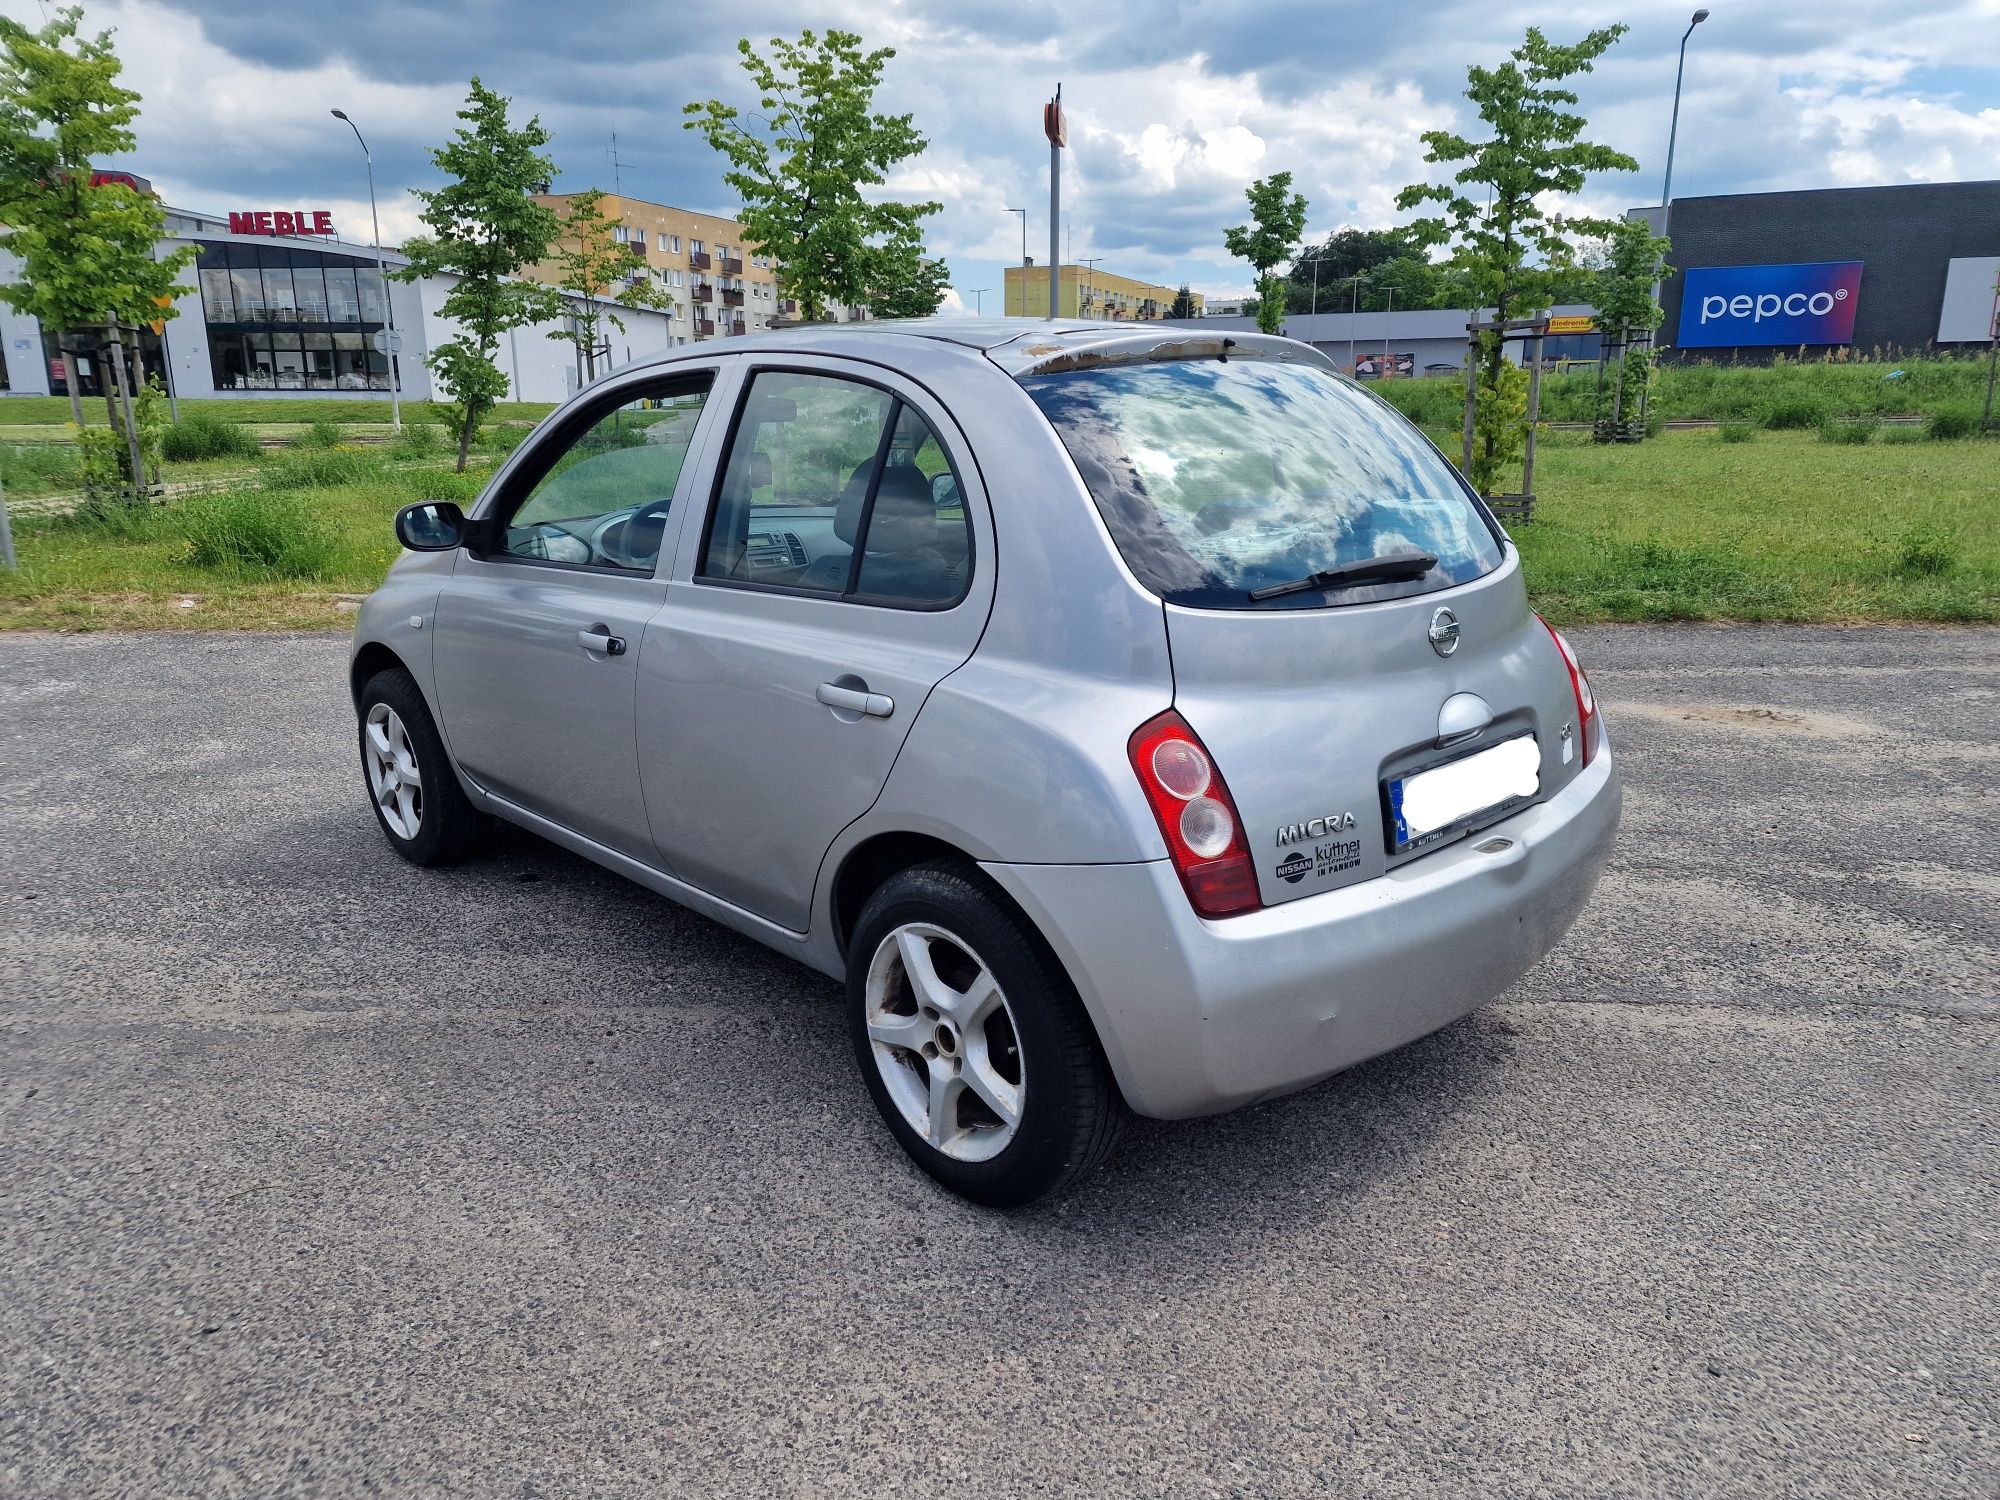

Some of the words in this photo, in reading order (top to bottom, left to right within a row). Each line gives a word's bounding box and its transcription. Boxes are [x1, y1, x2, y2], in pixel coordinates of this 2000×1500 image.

[229, 211, 334, 235] MEBLE
[1701, 292, 1834, 324] pepco
[1276, 811, 1357, 847] MICRA
[1315, 840, 1361, 862] küttner
[1277, 861, 1312, 877] NISSAN
[1317, 868, 1326, 877] IN
[1328, 859, 1361, 874] PANKOW
